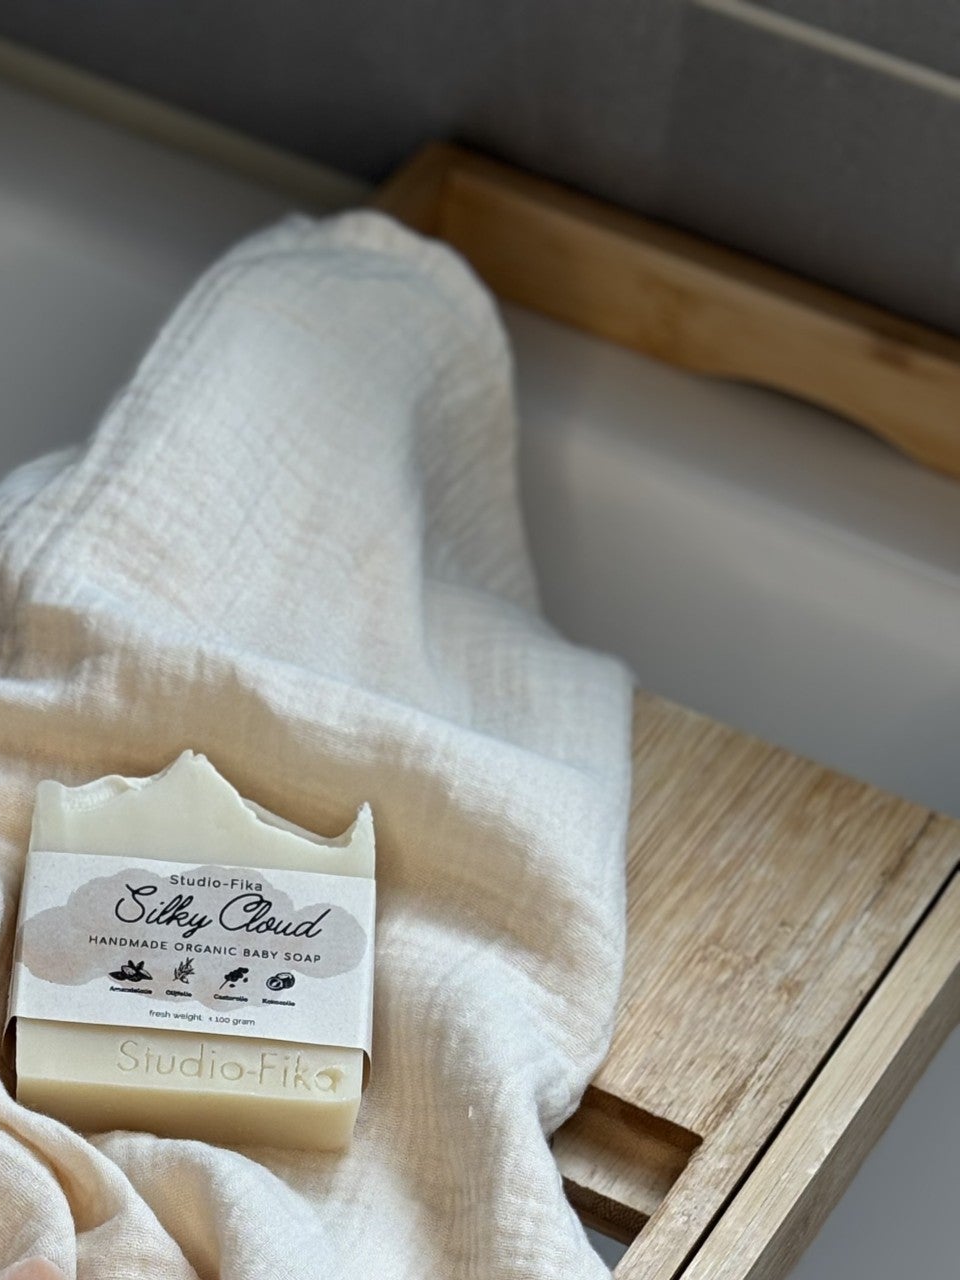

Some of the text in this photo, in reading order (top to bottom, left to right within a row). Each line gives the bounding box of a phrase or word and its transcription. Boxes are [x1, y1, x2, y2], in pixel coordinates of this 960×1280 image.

[170, 874, 263, 892] Studio-Fika
[115, 884, 331, 938] Silky Cloud
[88, 935, 321, 963] HANDMADE ORGANIC BABY SOAP
[149, 1009, 171, 1019] fresh
[215, 1016, 231, 1024] 100
[232, 1018, 255, 1026] gram
[117, 1040, 344, 1093] Studio-Fika
